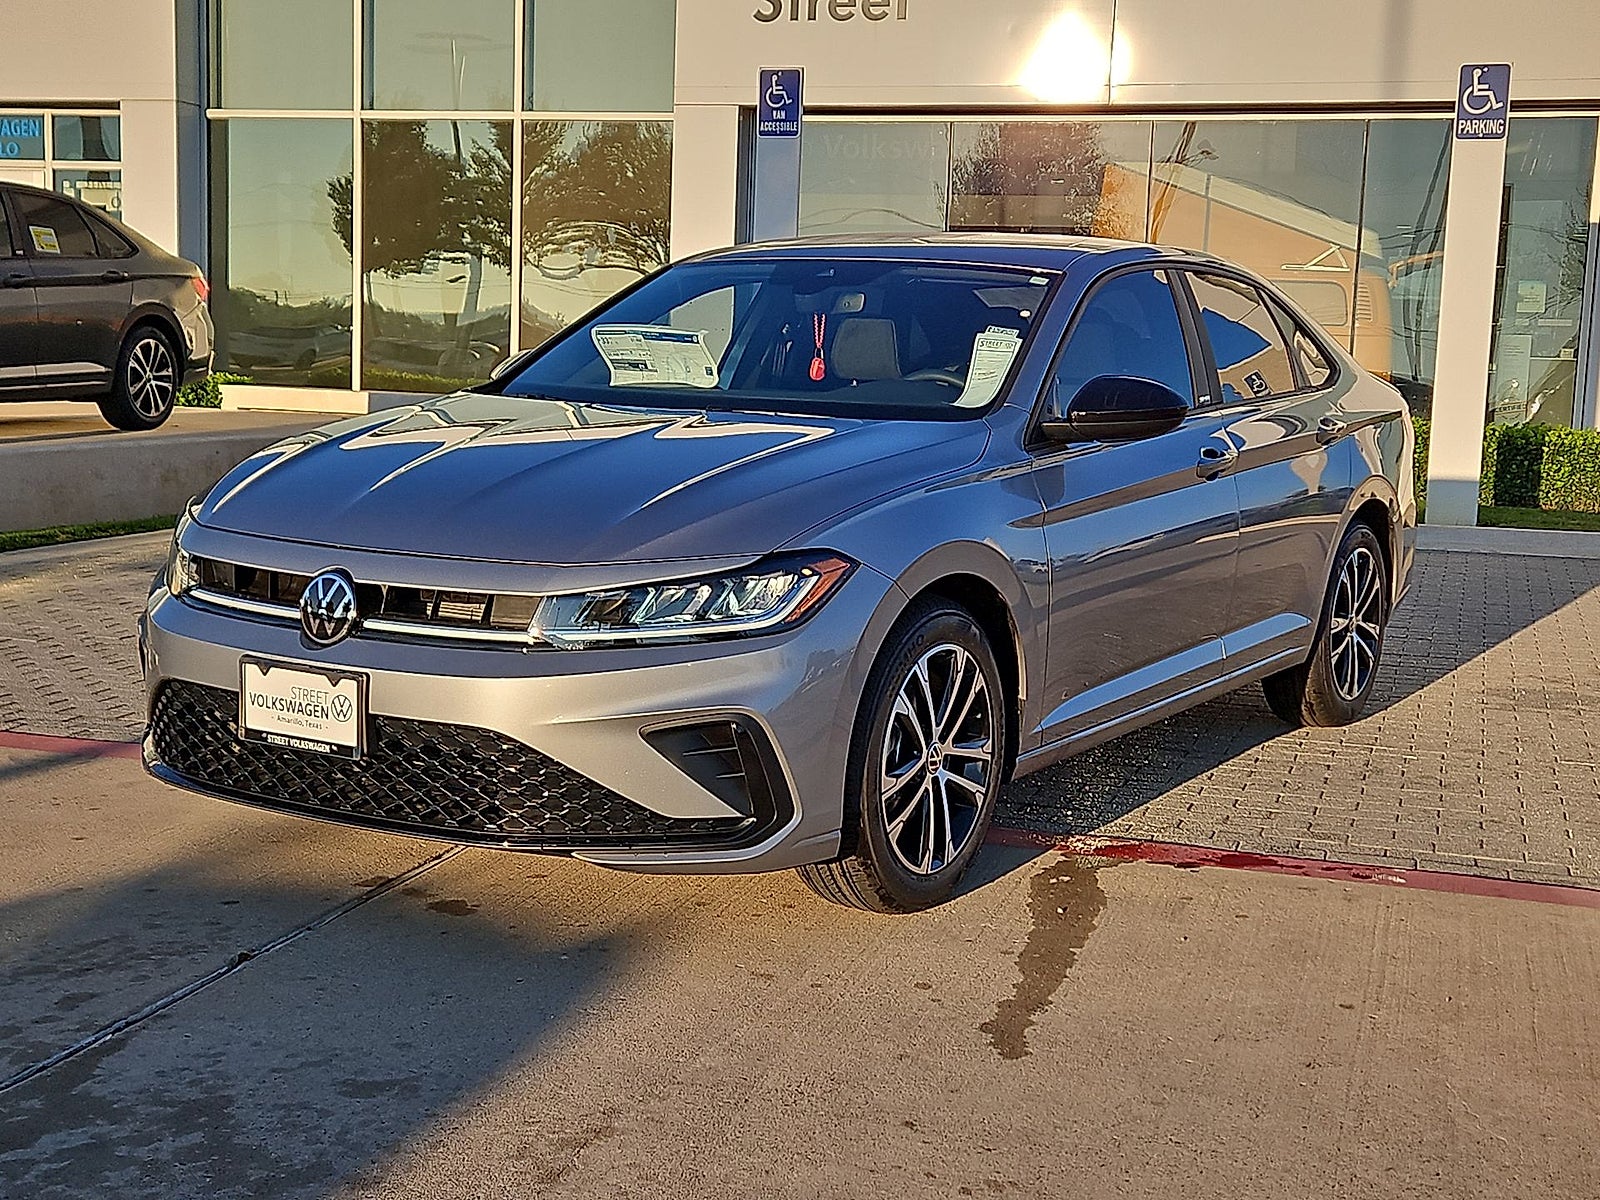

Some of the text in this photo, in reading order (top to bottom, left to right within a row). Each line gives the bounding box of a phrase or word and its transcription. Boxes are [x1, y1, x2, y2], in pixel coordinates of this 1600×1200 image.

[773, 110, 785, 120] VAN
[0, 119, 39, 137] AGEN
[760, 121, 797, 132] ACCESSIBLE
[1458, 119, 1505, 134] PARKING
[291, 686, 330, 706] STREET
[249, 691, 329, 720] VOLKSWAGEN
[305, 719, 323, 730] Texas
[267, 734, 331, 753] STREET VOLKSWAGEN
